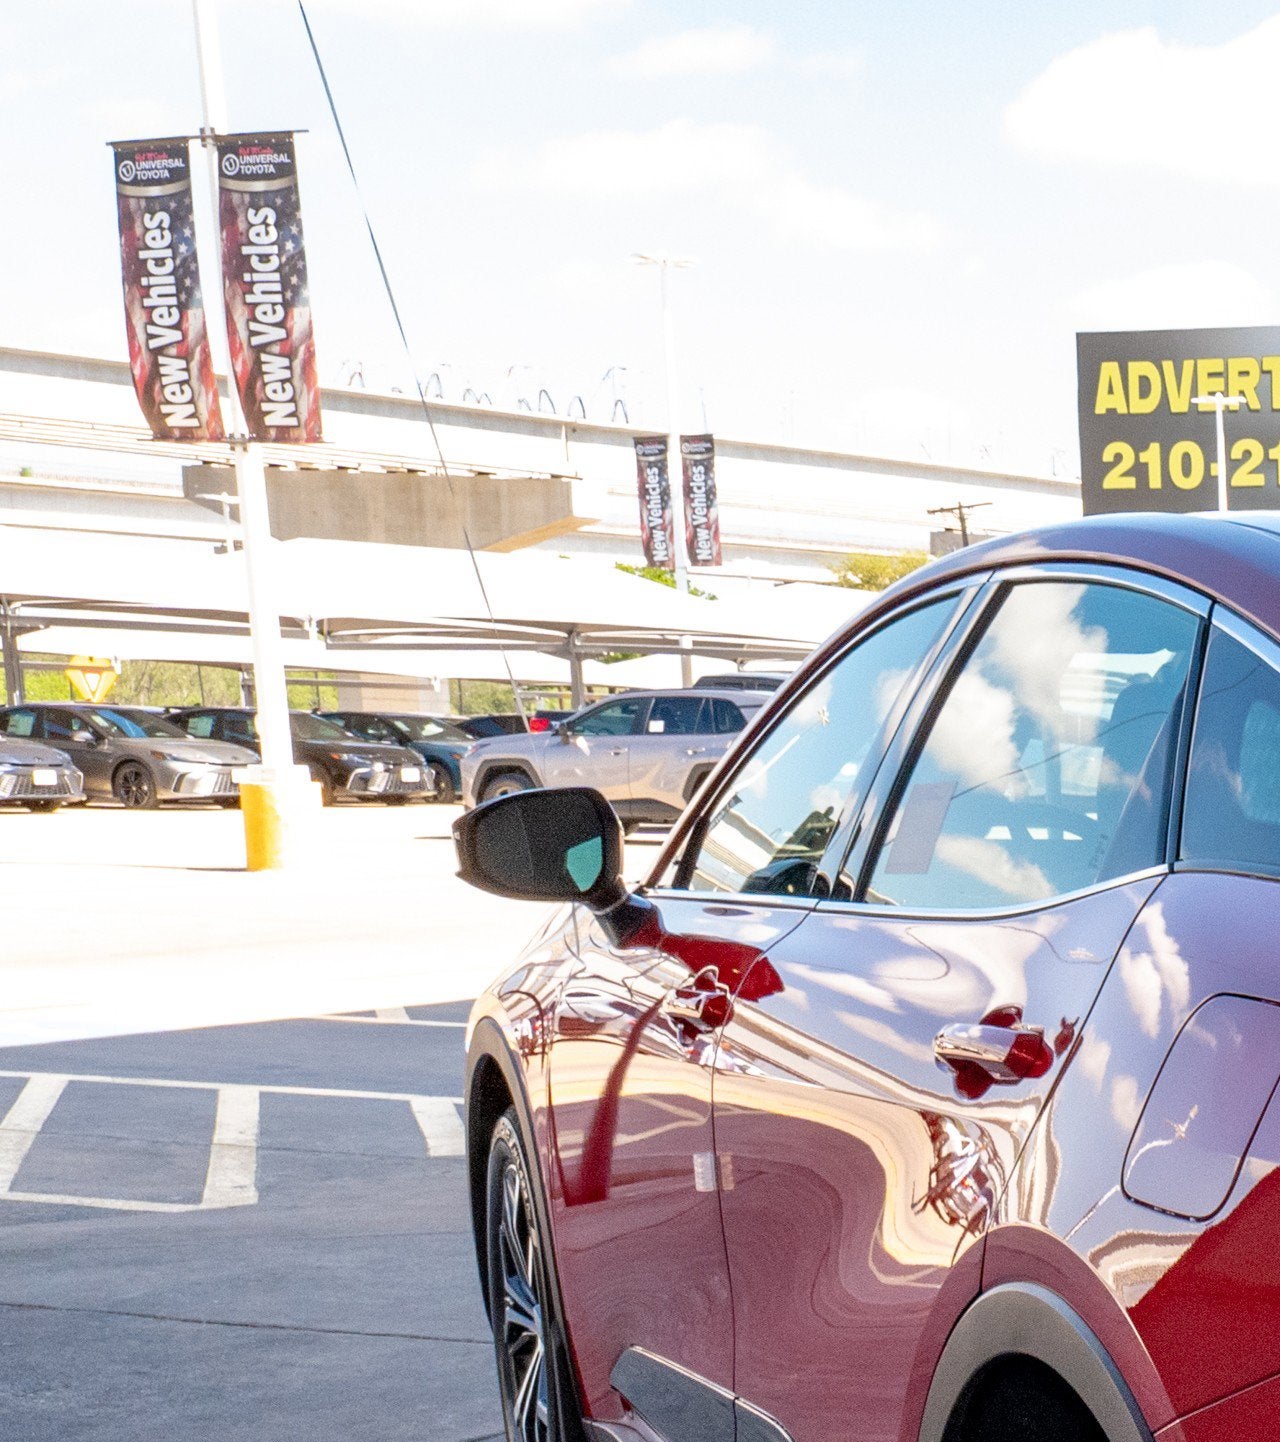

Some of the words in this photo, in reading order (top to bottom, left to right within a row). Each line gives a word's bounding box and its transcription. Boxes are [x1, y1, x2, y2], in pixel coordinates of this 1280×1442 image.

[135, 158, 185, 170] UNIVERSAL
[136, 169, 170, 180] TOYOTA
[240, 153, 291, 164] UNIVERSAL
[240, 164, 276, 175] TOYOTA
[138, 210, 183, 350] Vehicles
[241, 206, 288, 347] Vehicles
[158, 354, 200, 428] New
[260, 352, 299, 427] New
[646, 466, 663, 527] Vehicles
[689, 465, 708, 526] Vehicles
[652, 530, 669, 562] New
[696, 528, 712, 560] New
